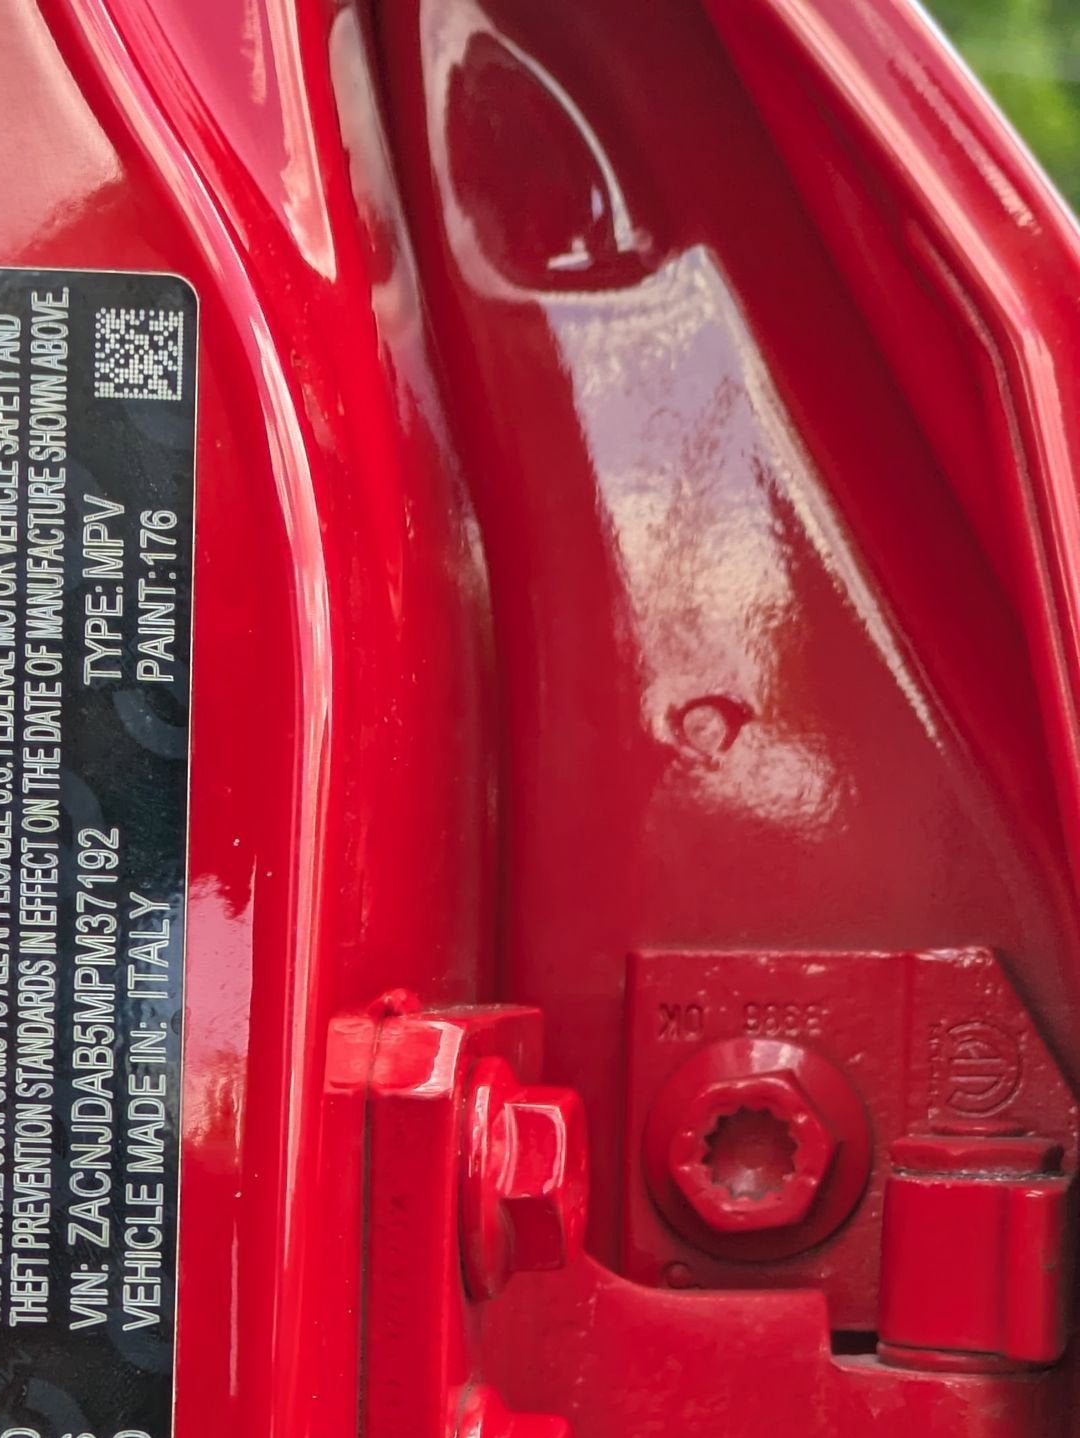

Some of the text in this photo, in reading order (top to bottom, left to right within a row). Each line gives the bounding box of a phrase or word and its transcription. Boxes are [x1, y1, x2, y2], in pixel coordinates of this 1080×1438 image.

[9, 286, 70, 1327] THEFT PREVENTION STANDARDS IN EFFECT ON THE DATE OF MANUFACTURE SHOWN ABOVE.
[67, 826, 121, 1331] VIN: ZACNJDAB5MPM37192
[122, 891, 171, 1331] VEHICLE MADE IN: ITALY
